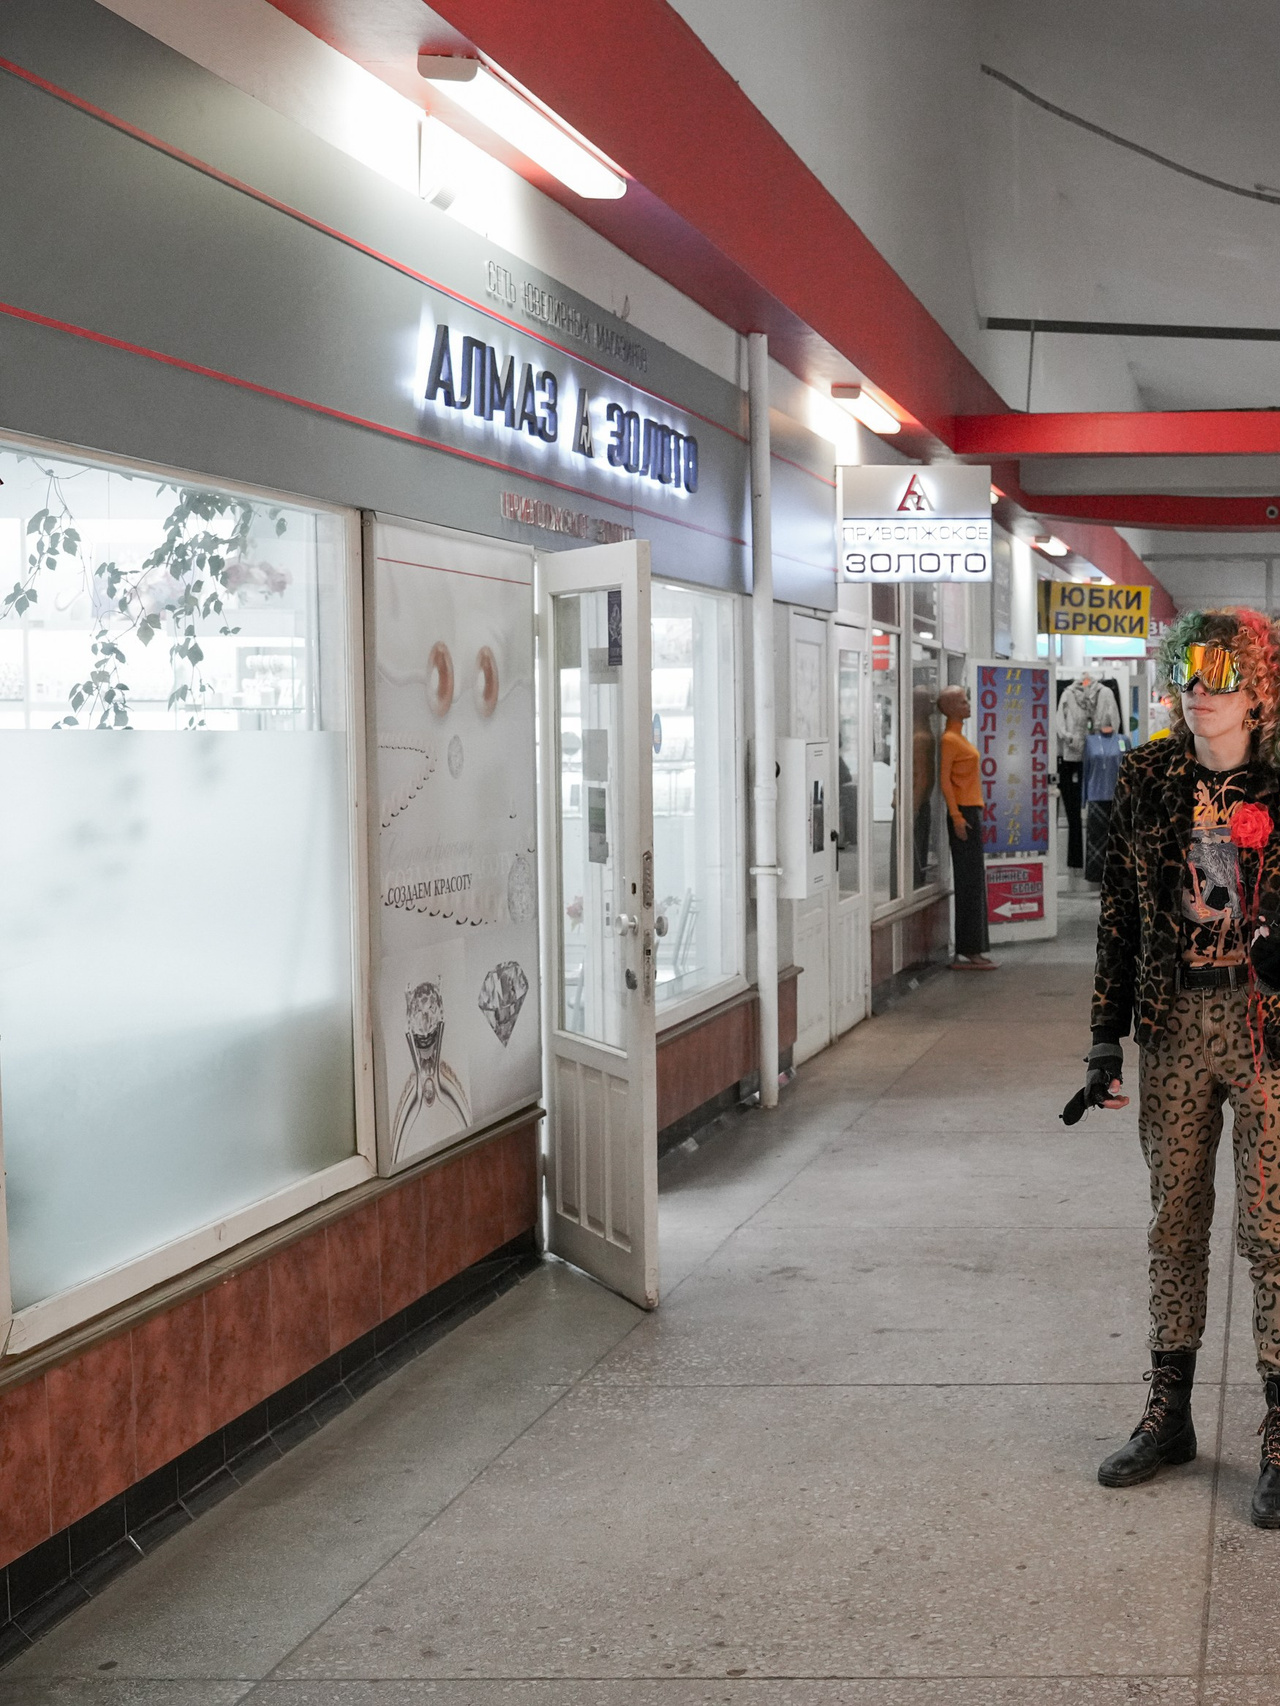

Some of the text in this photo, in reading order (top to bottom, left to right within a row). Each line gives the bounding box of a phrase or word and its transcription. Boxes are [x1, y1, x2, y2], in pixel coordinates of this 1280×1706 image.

[486, 260, 517, 304] СЕТЬ
[522, 281, 591, 344] ЮВЕЛИРНЫХ
[425, 324, 559, 443] АЛМАЗ
[607, 402, 699, 494] ЗОЛОТО
[842, 525, 989, 542] ПРИВОЛЖСКОЕ
[845, 552, 987, 574] ЗОЛОТО
[1060, 586, 1142, 612] ЮБКИ
[1054, 611, 1145, 635] БРЮКИ
[980, 667, 998, 843] КОЛГОТКИ
[1031, 668, 1048, 843] КУПАЛЬНИКИ
[387, 873, 473, 905] СОЗДАЕМ КРАСОТУ
